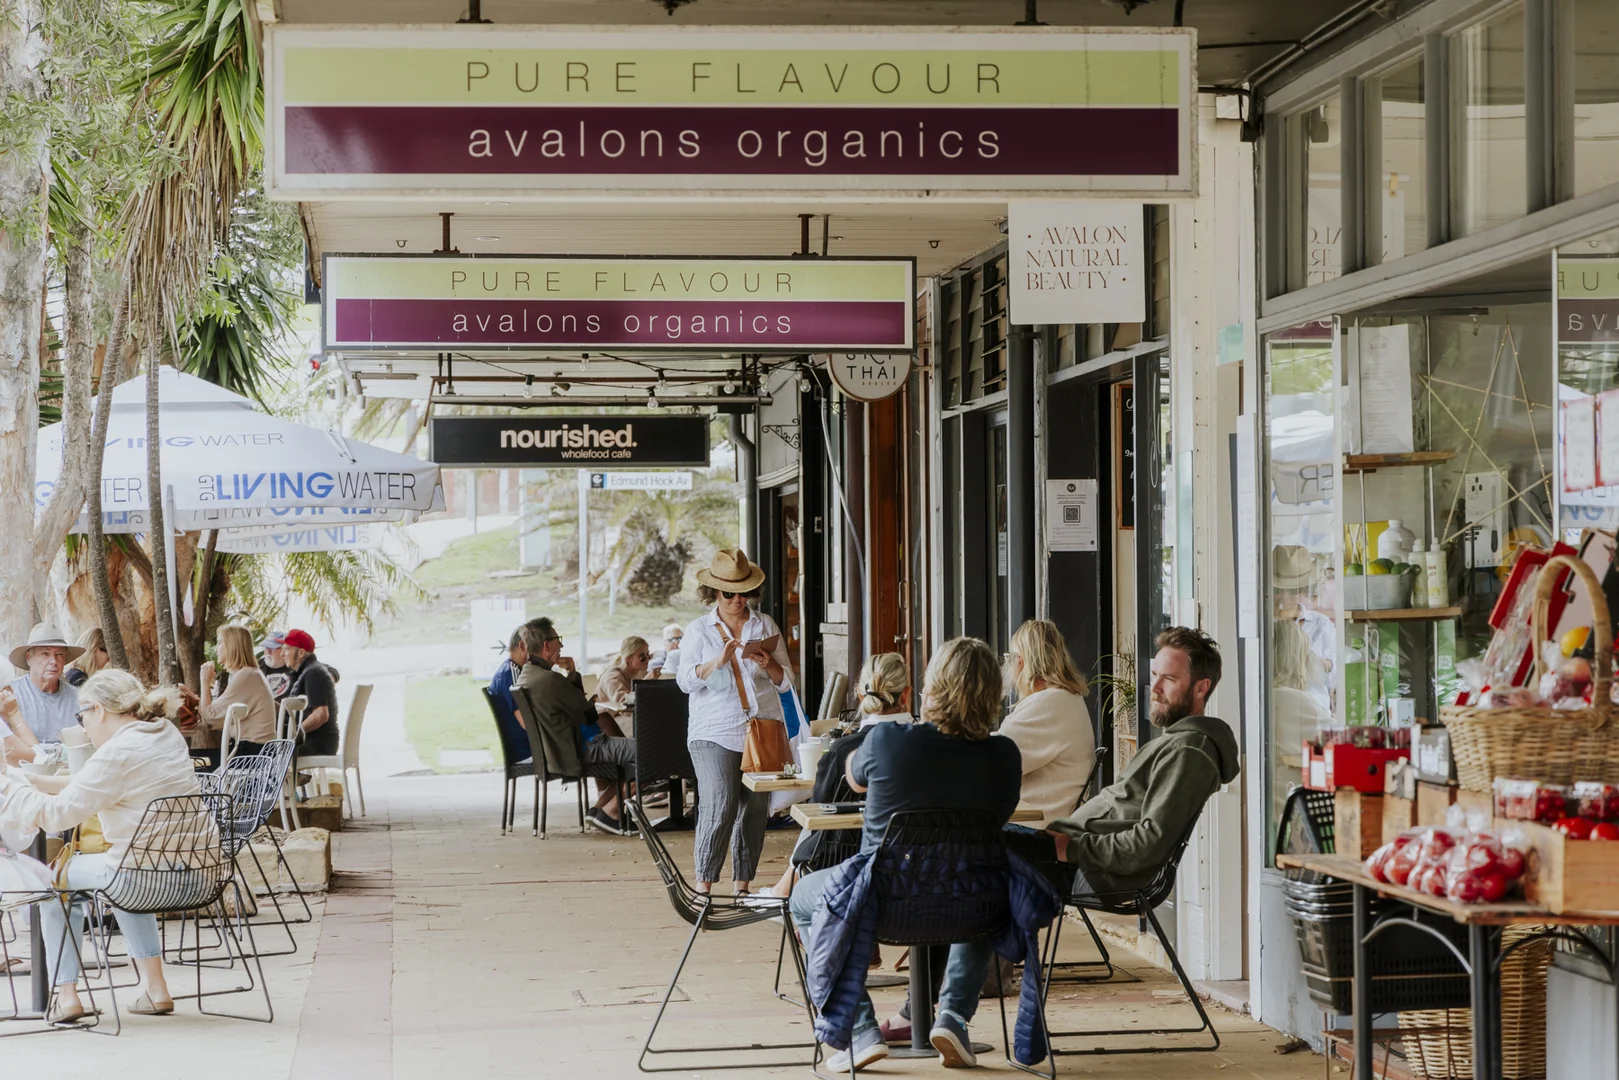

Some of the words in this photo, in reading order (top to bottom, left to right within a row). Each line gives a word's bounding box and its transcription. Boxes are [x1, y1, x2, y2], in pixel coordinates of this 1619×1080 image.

[467, 61, 637, 93] PURE
[692, 62, 1000, 94] FLAVOUR
[468, 120, 701, 158] avalons
[737, 121, 1000, 167] organics
[1041, 225, 1127, 245] AVALON
[1026, 248, 1128, 268] NATURAL
[451, 271, 560, 292] PURE
[594, 272, 792, 293] FLAVOUR
[1026, 270, 1111, 290] BEAUTY
[452, 308, 601, 333] avalons
[623, 309, 792, 339] organics
[846, 365, 897, 379] THAI
[199, 432, 284, 446] WATER
[500, 423, 638, 448] nourished.
[561, 449, 609, 459] wholefood
[611, 449, 632, 459] cafe
[216, 471, 335, 501] LIVING
[338, 471, 417, 502] WATER
[611, 475, 648, 486] Edmund
[676, 475, 689, 486] Av
